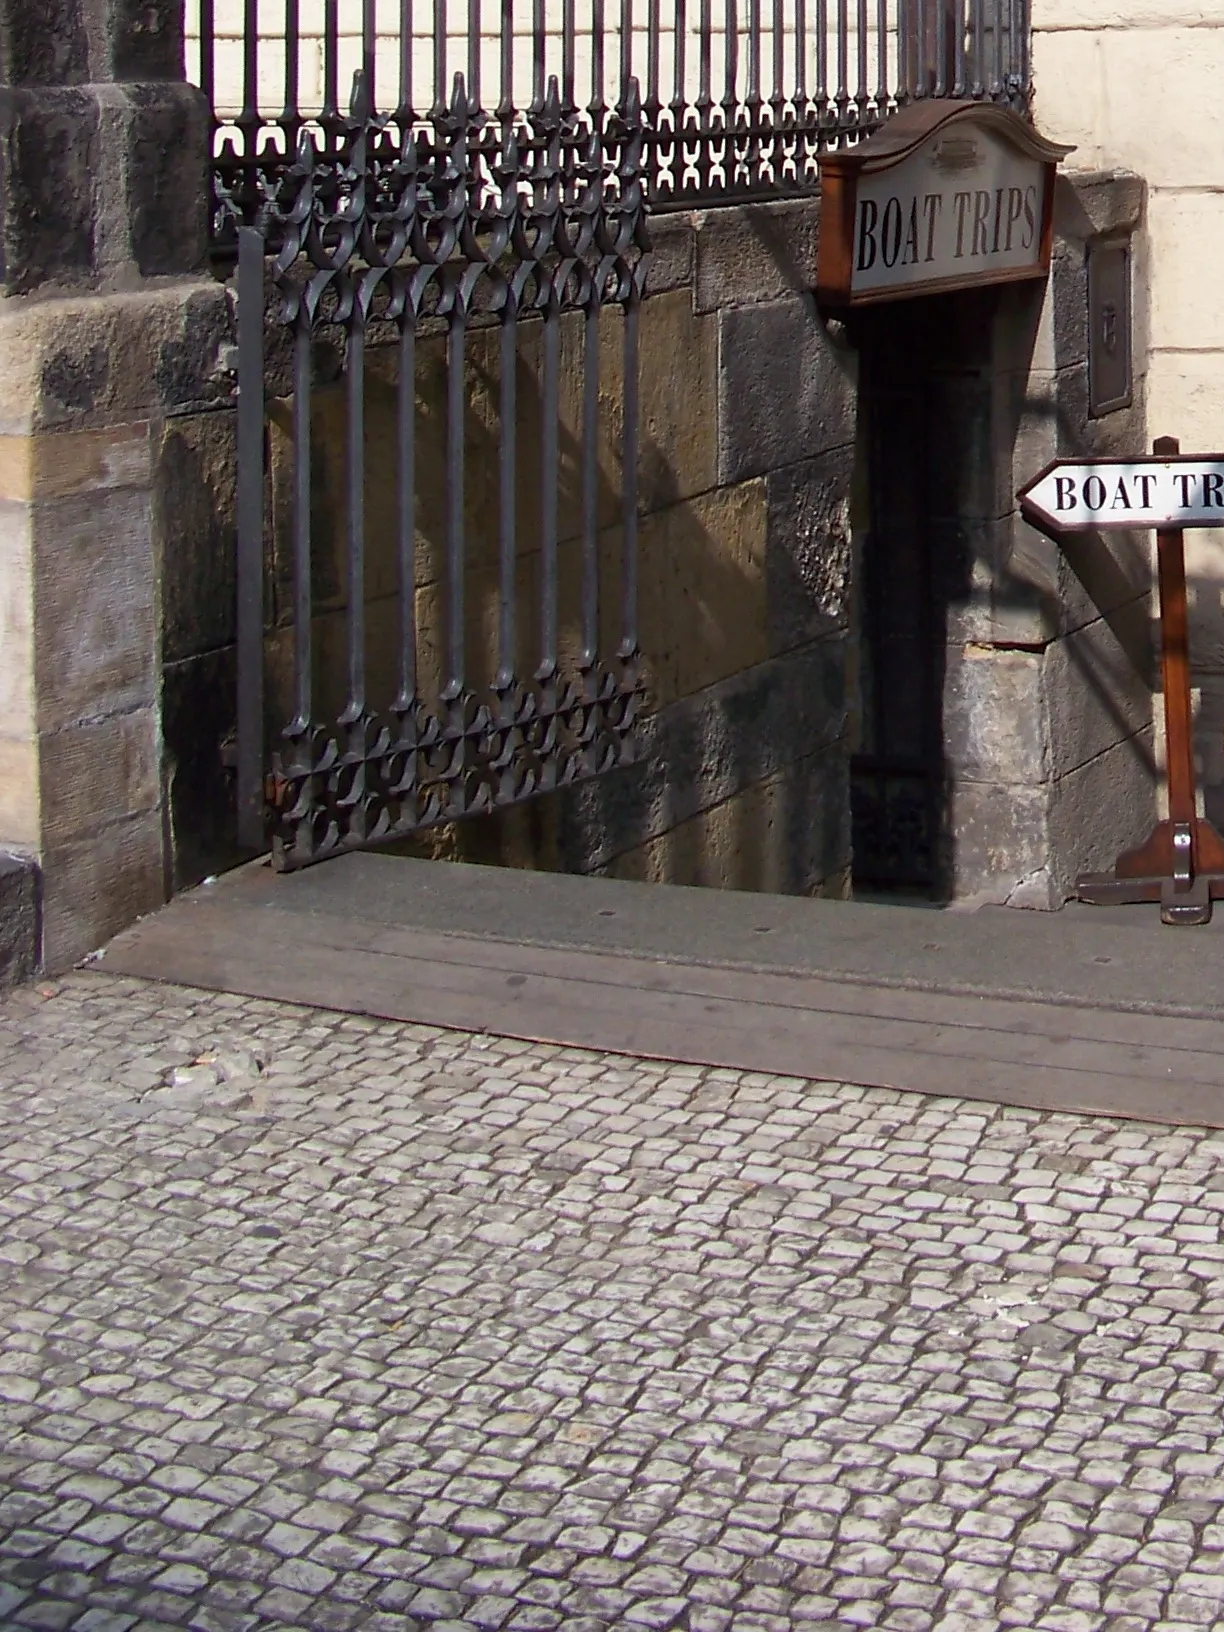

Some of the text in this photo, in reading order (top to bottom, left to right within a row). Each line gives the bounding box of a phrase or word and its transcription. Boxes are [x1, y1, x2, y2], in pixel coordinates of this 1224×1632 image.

[856, 185, 1037, 271] BOAT TRIPS
[1054, 474, 1158, 511] BOAT
